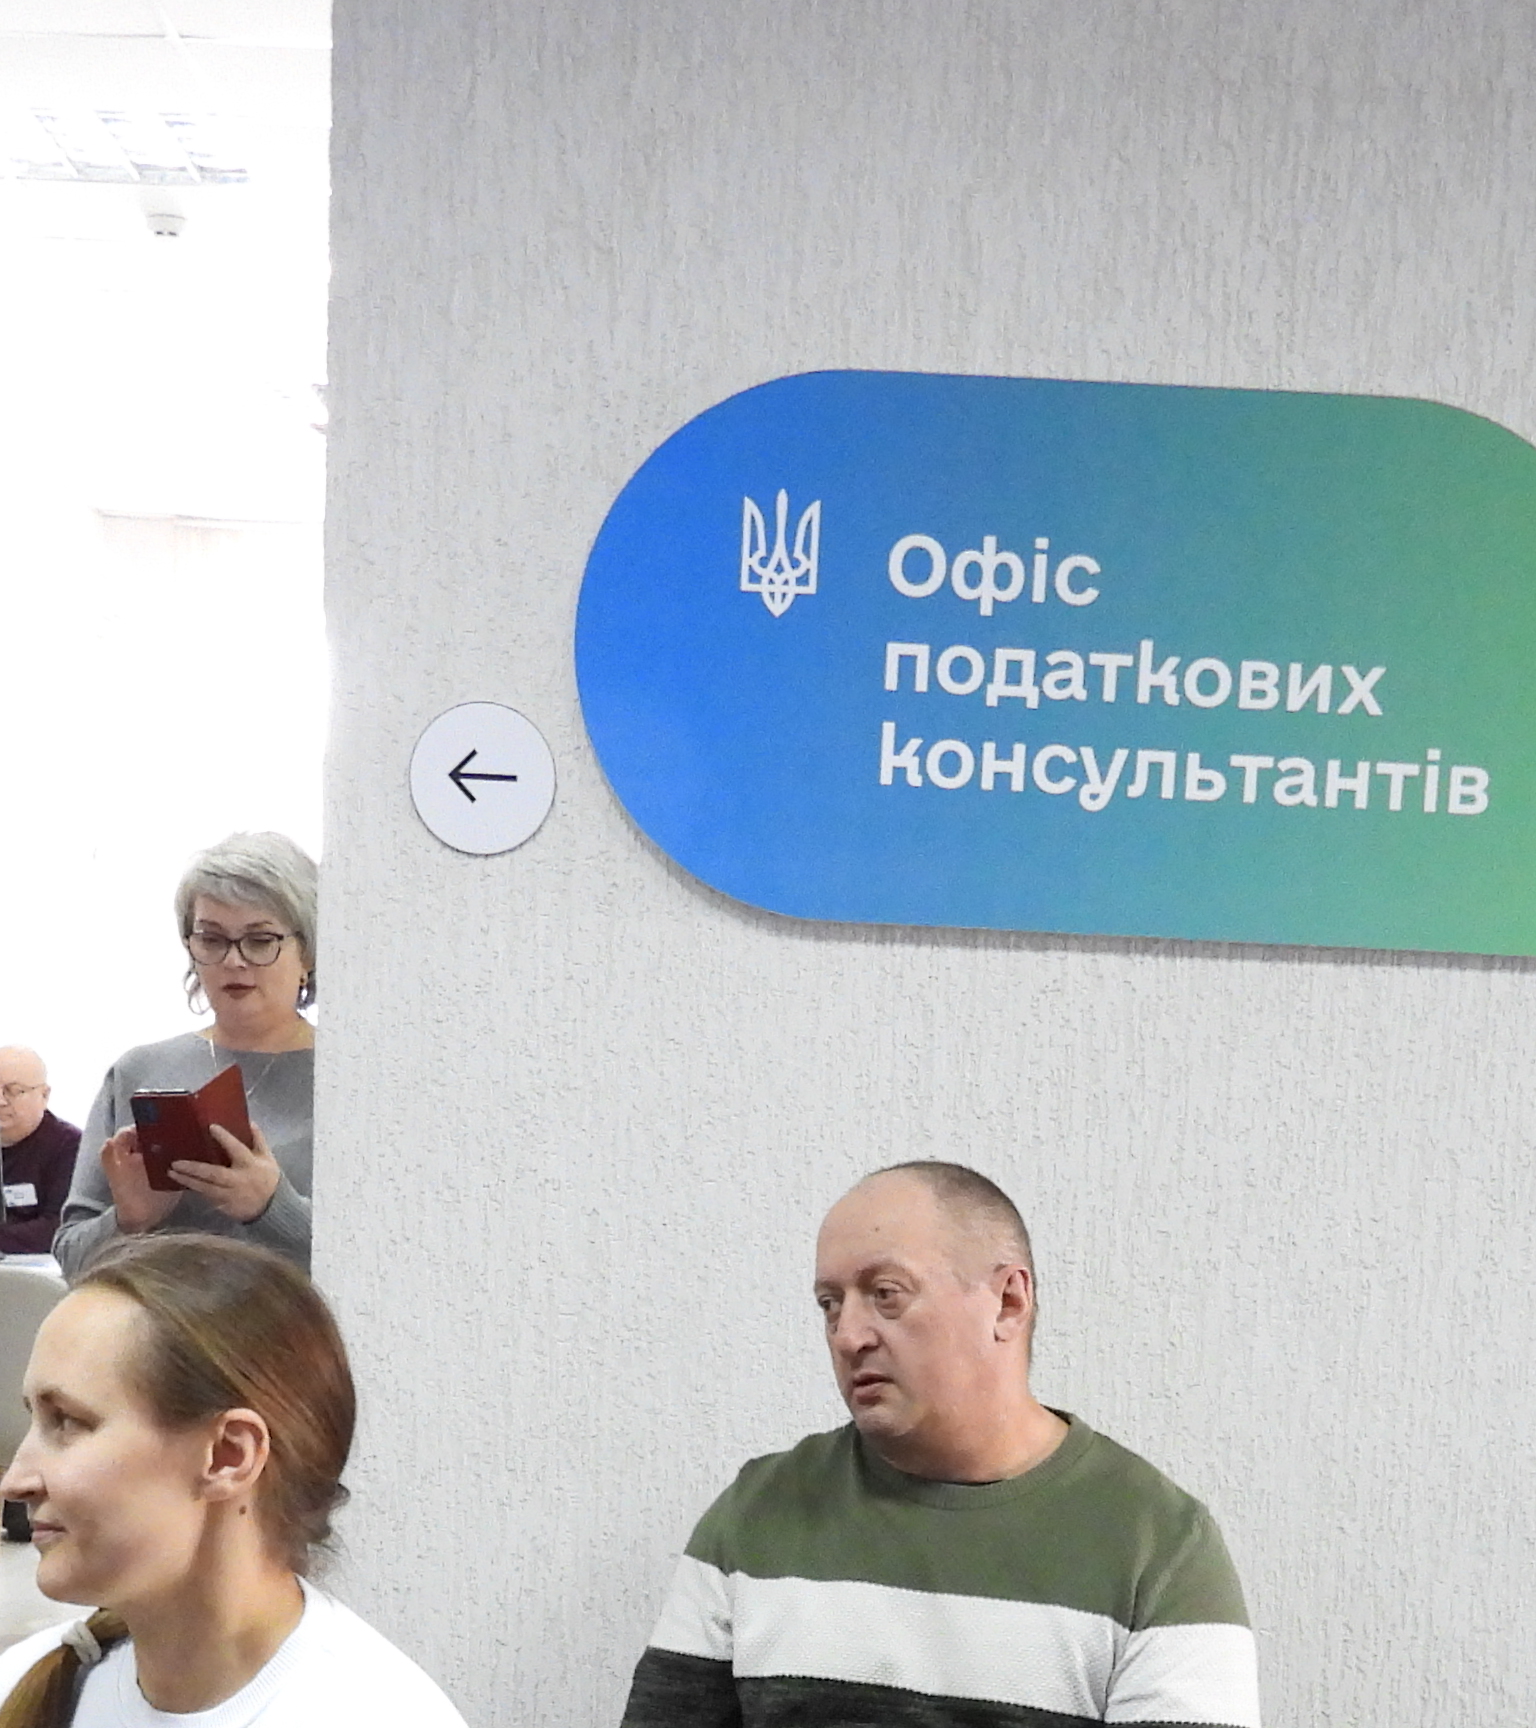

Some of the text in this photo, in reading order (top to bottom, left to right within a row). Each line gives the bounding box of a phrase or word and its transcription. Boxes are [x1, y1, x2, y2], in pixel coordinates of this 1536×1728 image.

[888, 534, 1102, 616] Офіс
[884, 638, 1387, 717] податкових
[879, 721, 1490, 815] консультантів
